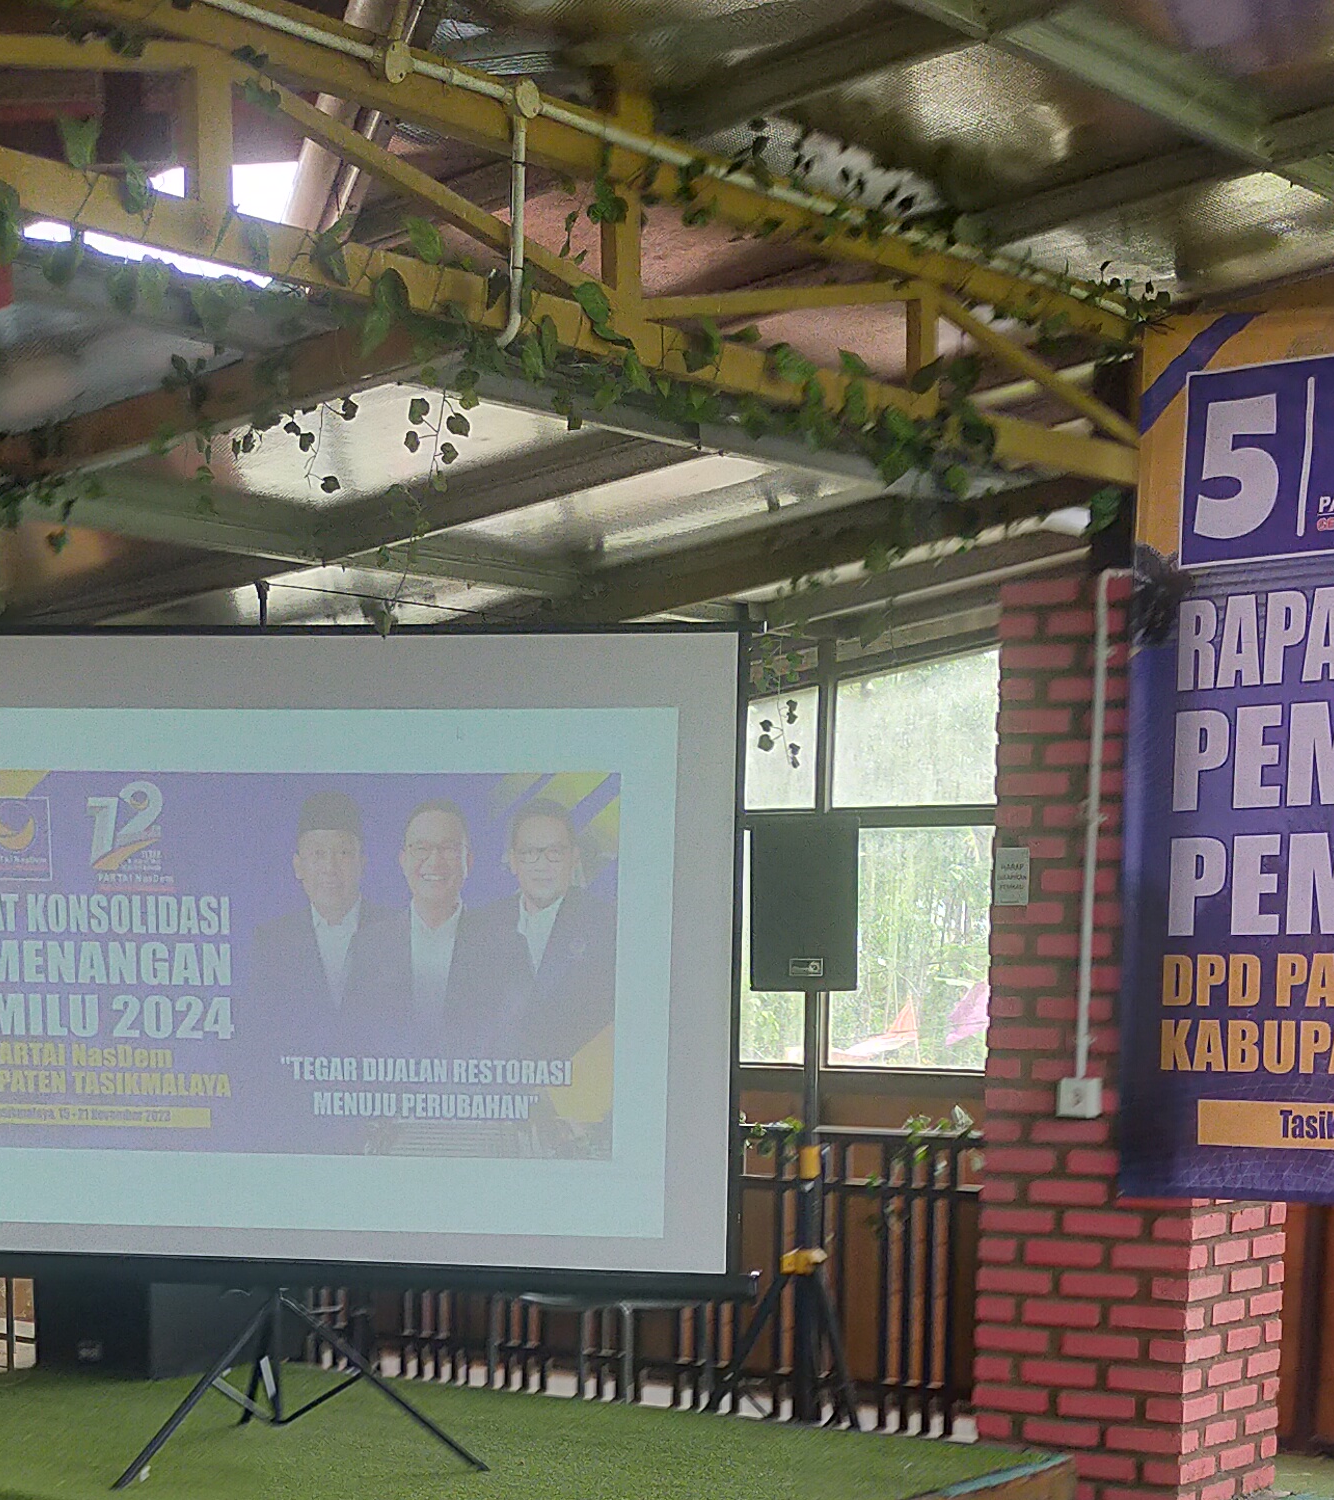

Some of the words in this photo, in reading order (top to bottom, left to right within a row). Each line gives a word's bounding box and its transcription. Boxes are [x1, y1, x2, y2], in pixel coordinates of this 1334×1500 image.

[1193, 393, 1279, 539] 5
[98, 874, 133, 884] PARTAI
[27, 893, 231, 936] KONSOLIDASI
[1161, 953, 1261, 1008] DPD
[112, 994, 235, 1040] 2024
[71, 1042, 173, 1068] NasDem
[72, 1072, 232, 1097] TASIKMALAYA
[280, 1056, 358, 1081] "TEGAR
[362, 1057, 447, 1083] DIJALAN
[453, 1059, 572, 1085] RESTORASI
[313, 1091, 397, 1116] MENUJU
[402, 1093, 538, 1119] PERUBAHAN"
